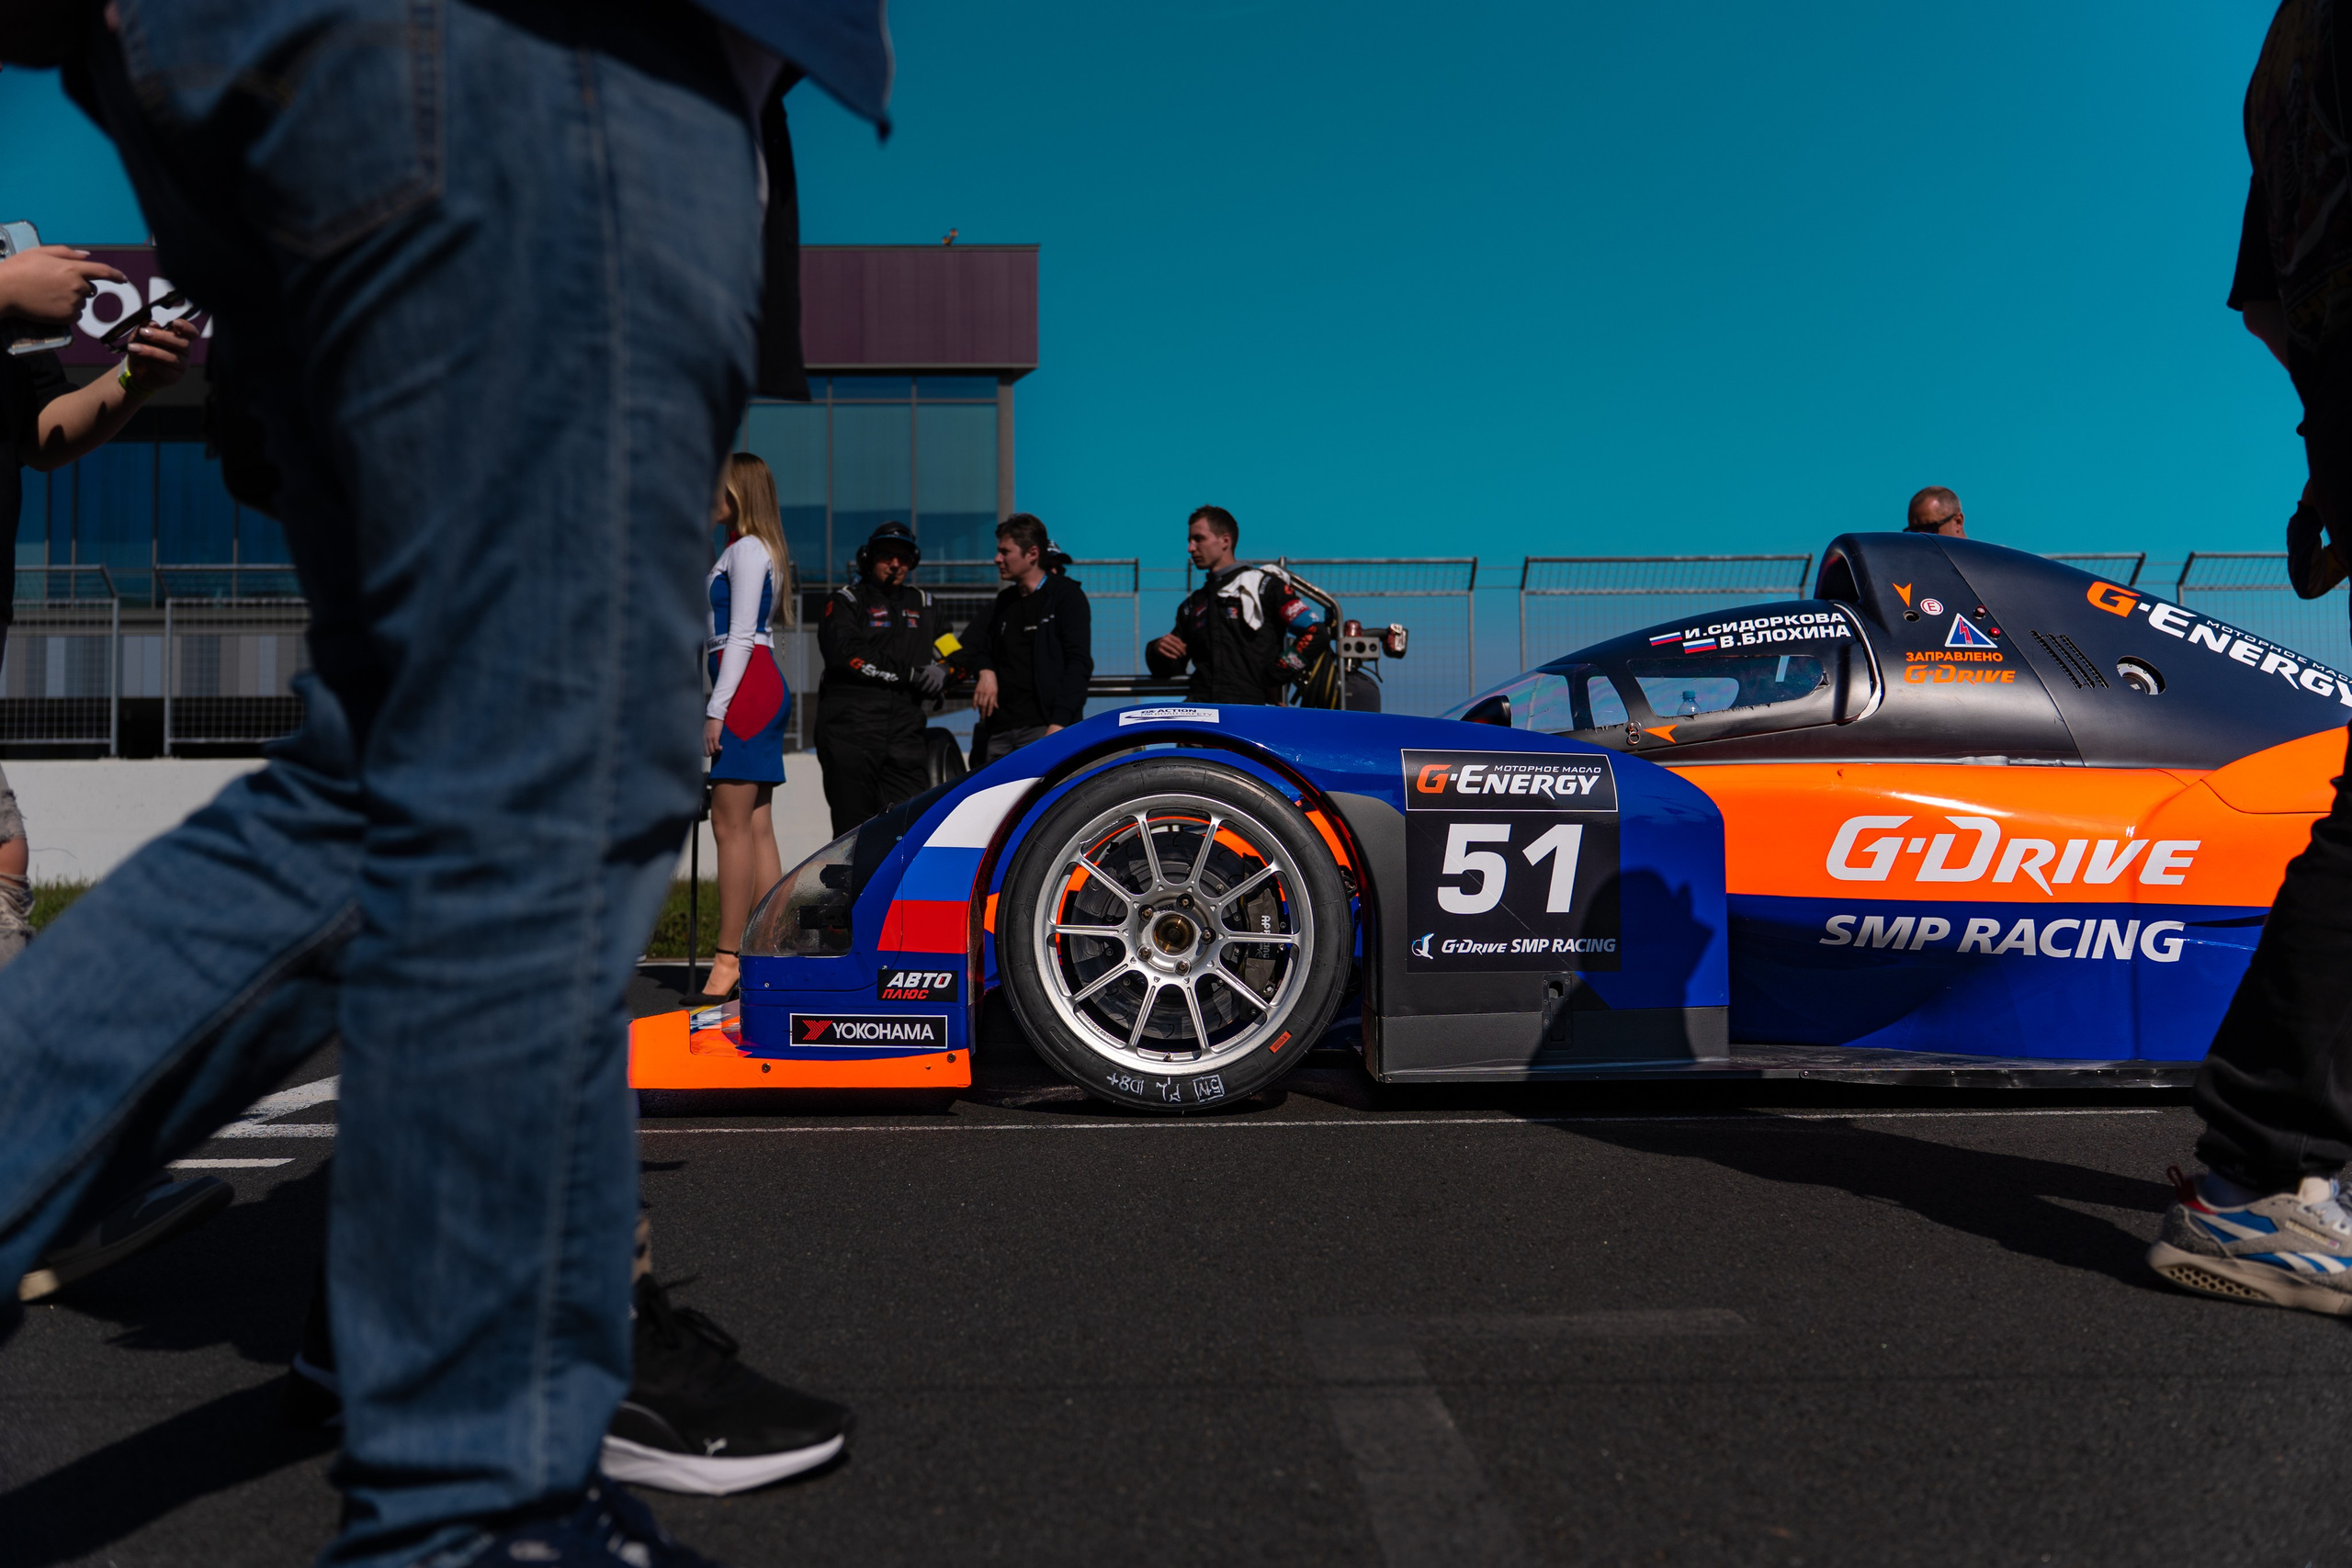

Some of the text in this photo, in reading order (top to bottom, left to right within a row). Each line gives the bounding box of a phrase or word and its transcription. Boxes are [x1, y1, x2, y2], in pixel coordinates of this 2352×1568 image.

[1685, 613, 1847, 638] И.СИДОРКОВА
[1720, 624, 1851, 649] В.БЛОХИНА
[2206, 620, 2308, 663] МОТОРНОЕ
[1905, 652, 2003, 662] ЗАПРАВЛЕНО
[1437, 823, 1584, 915] 51
[1510, 939, 1550, 953] SMP
[1552, 938, 1616, 953] RACING
[1819, 915, 2187, 963] SMP RACING
[888, 972, 953, 988] АВТО
[882, 989, 929, 999] ПЛЮС
[832, 1022, 934, 1041] YOKOHAMA
